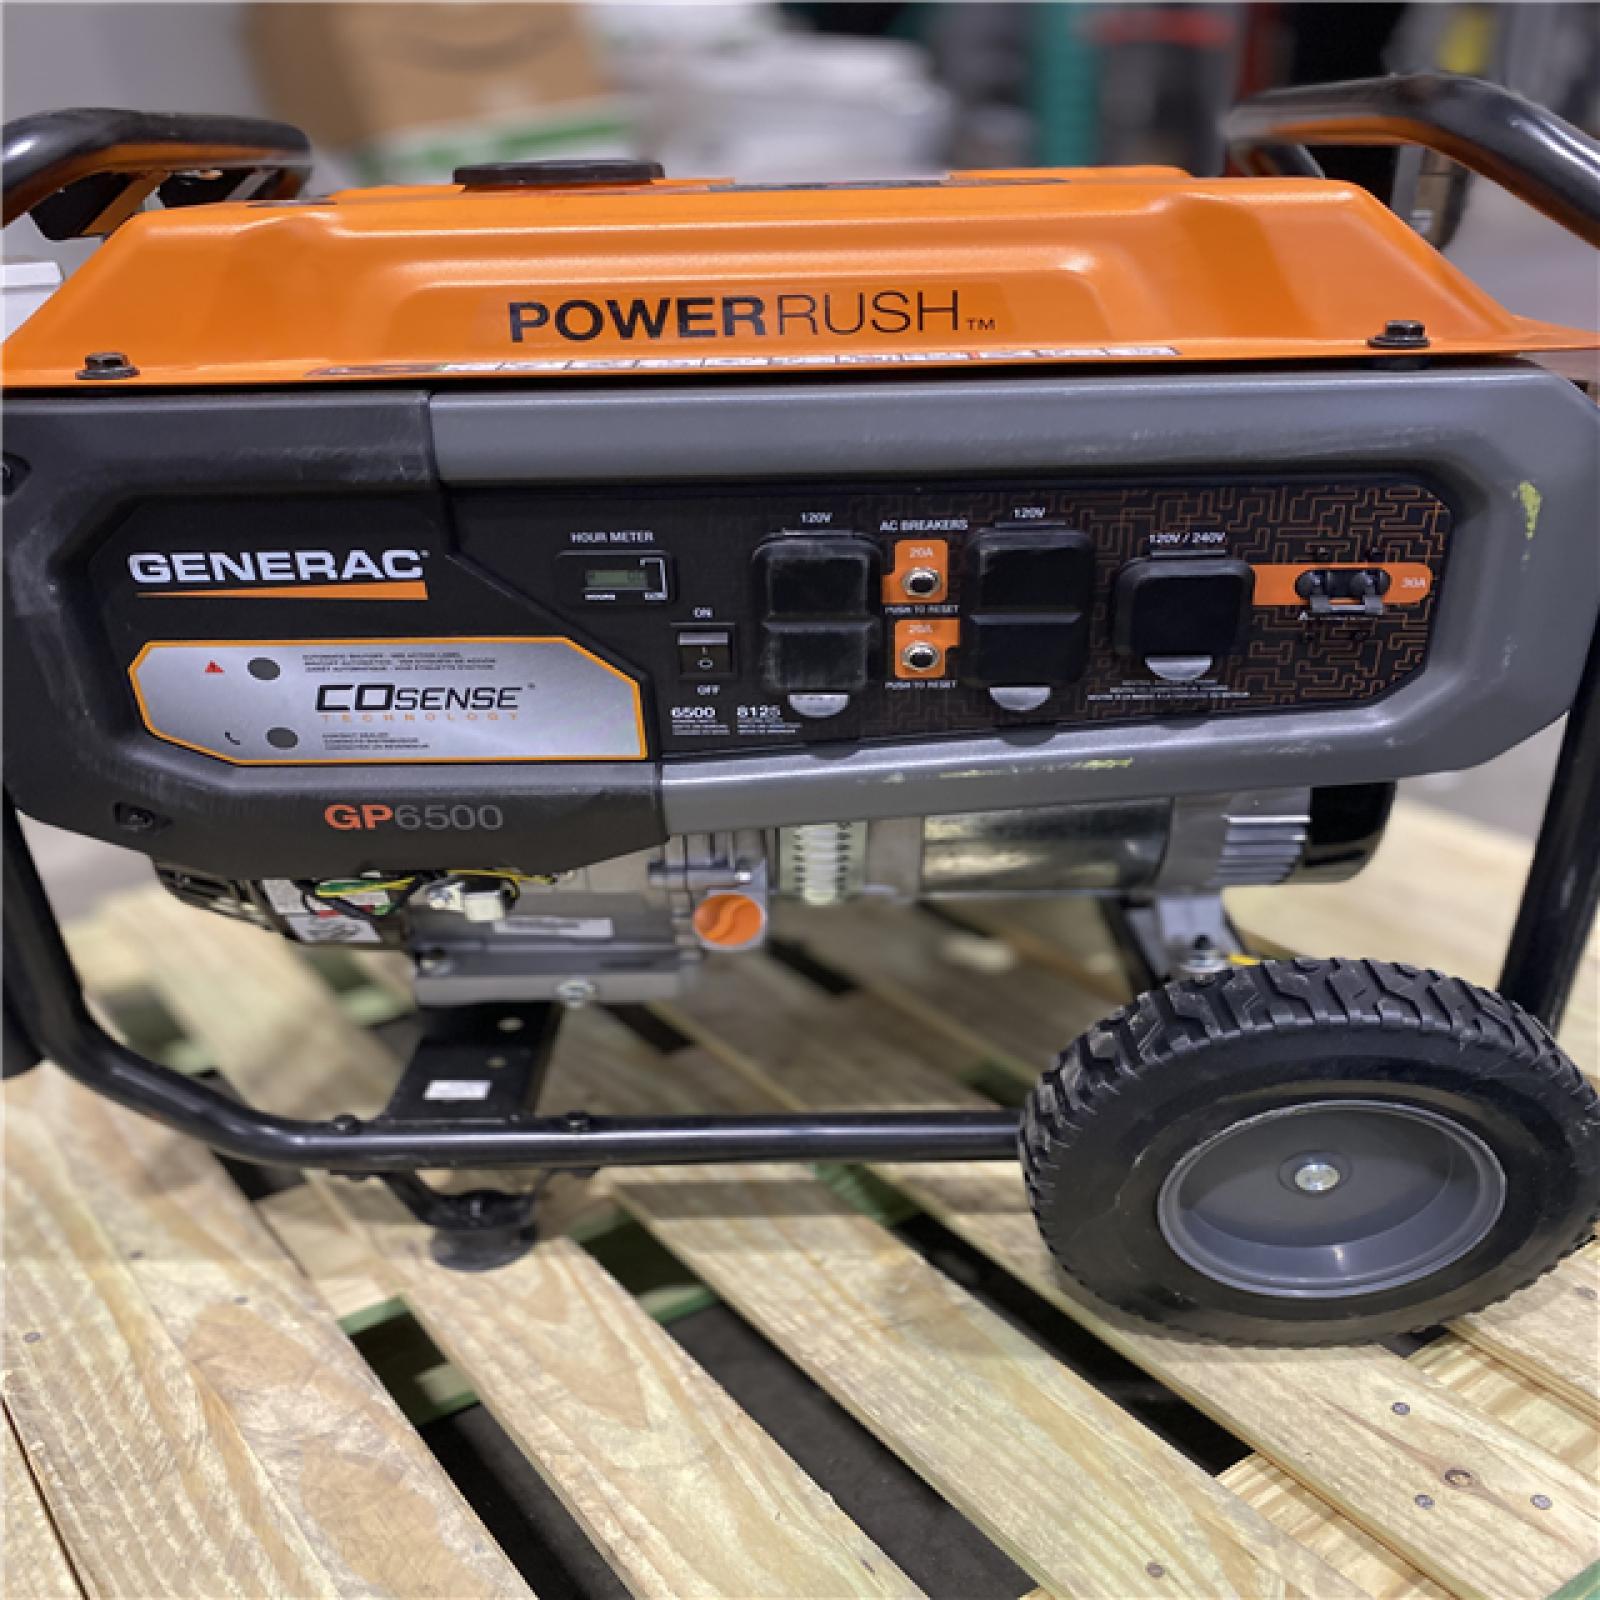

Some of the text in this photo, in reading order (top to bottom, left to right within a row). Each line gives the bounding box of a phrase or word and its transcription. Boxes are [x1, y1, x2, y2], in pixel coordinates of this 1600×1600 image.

[801, 512, 833, 523] 120V
[1013, 507, 1046, 518] 120V
[879, 520, 968, 531] AC BREAKERS
[570, 530, 655, 543] HOUR METER
[1149, 532, 1181, 544] 120V
[1191, 532, 1226, 544] 240V
[909, 547, 934, 558] 20A
[128, 549, 424, 584] GENERAC
[692, 607, 713, 618] ON
[697, 684, 720, 696] OFF
[321, 713, 519, 722] TECHNOLOGY
[670, 706, 716, 718] 6500
[323, 803, 505, 831] GP6500
